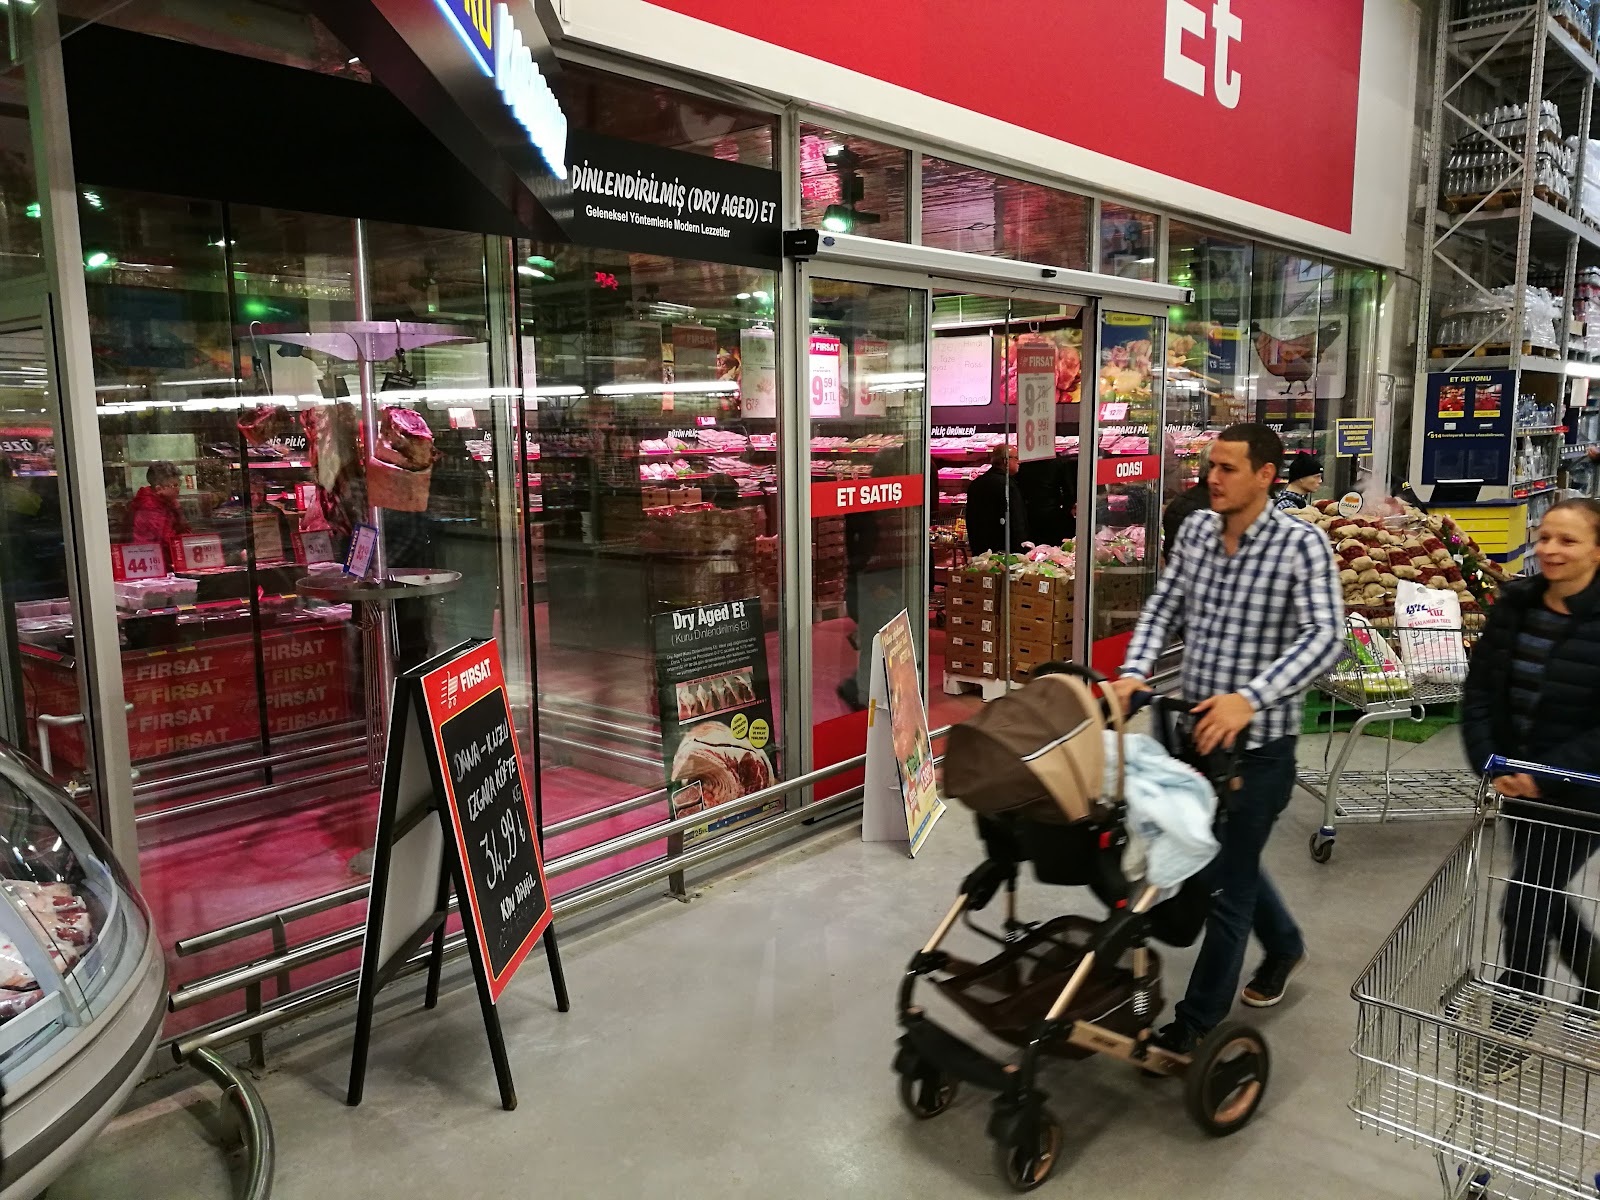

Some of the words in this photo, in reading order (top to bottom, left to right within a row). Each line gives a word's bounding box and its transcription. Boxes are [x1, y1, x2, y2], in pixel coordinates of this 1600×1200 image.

[1164, 0, 1242, 109] Et
[572, 159, 686, 216] DİNLENDİRİLMİŞ
[687, 186, 720, 215] (DRY
[721, 193, 759, 223] AGED)
[760, 200, 776, 223] ET
[586, 204, 628, 222] Geleneksel
[629, 211, 673, 230] Yöntemlerle
[674, 219, 700, 234] Modern
[701, 223, 730, 238] Lezzetler
[815, 342, 839, 353] FIRSAT
[1029, 356, 1054, 367] FIRSAT
[812, 376, 823, 405] 9
[285, 435, 306, 449] PİLİÇ
[1025, 419, 1035, 452] 8
[1116, 461, 1143, 478] ODASI
[837, 487, 856, 507] ET
[860, 482, 902, 505] SATIŞ
[128, 558, 148, 573] 44
[193, 546, 204, 563] 8
[673, 613, 695, 631] Dry
[698, 603, 730, 627] Aged
[731, 601, 745, 619] Et
[262, 639, 326, 662] FIRSAT
[136, 656, 213, 681] FIRSAT
[272, 660, 337, 684] FIRSAT
[460, 658, 491, 693] FIRSAT
[152, 678, 226, 704] FIRSAT
[266, 685, 327, 709] FIRSAT
[139, 705, 214, 733] FIRSAT
[277, 707, 339, 733] FIRSAT
[155, 727, 230, 755] FIRSAT
[495, 754, 517, 791] KÖFTE
[480, 807, 518, 890] 34,99
